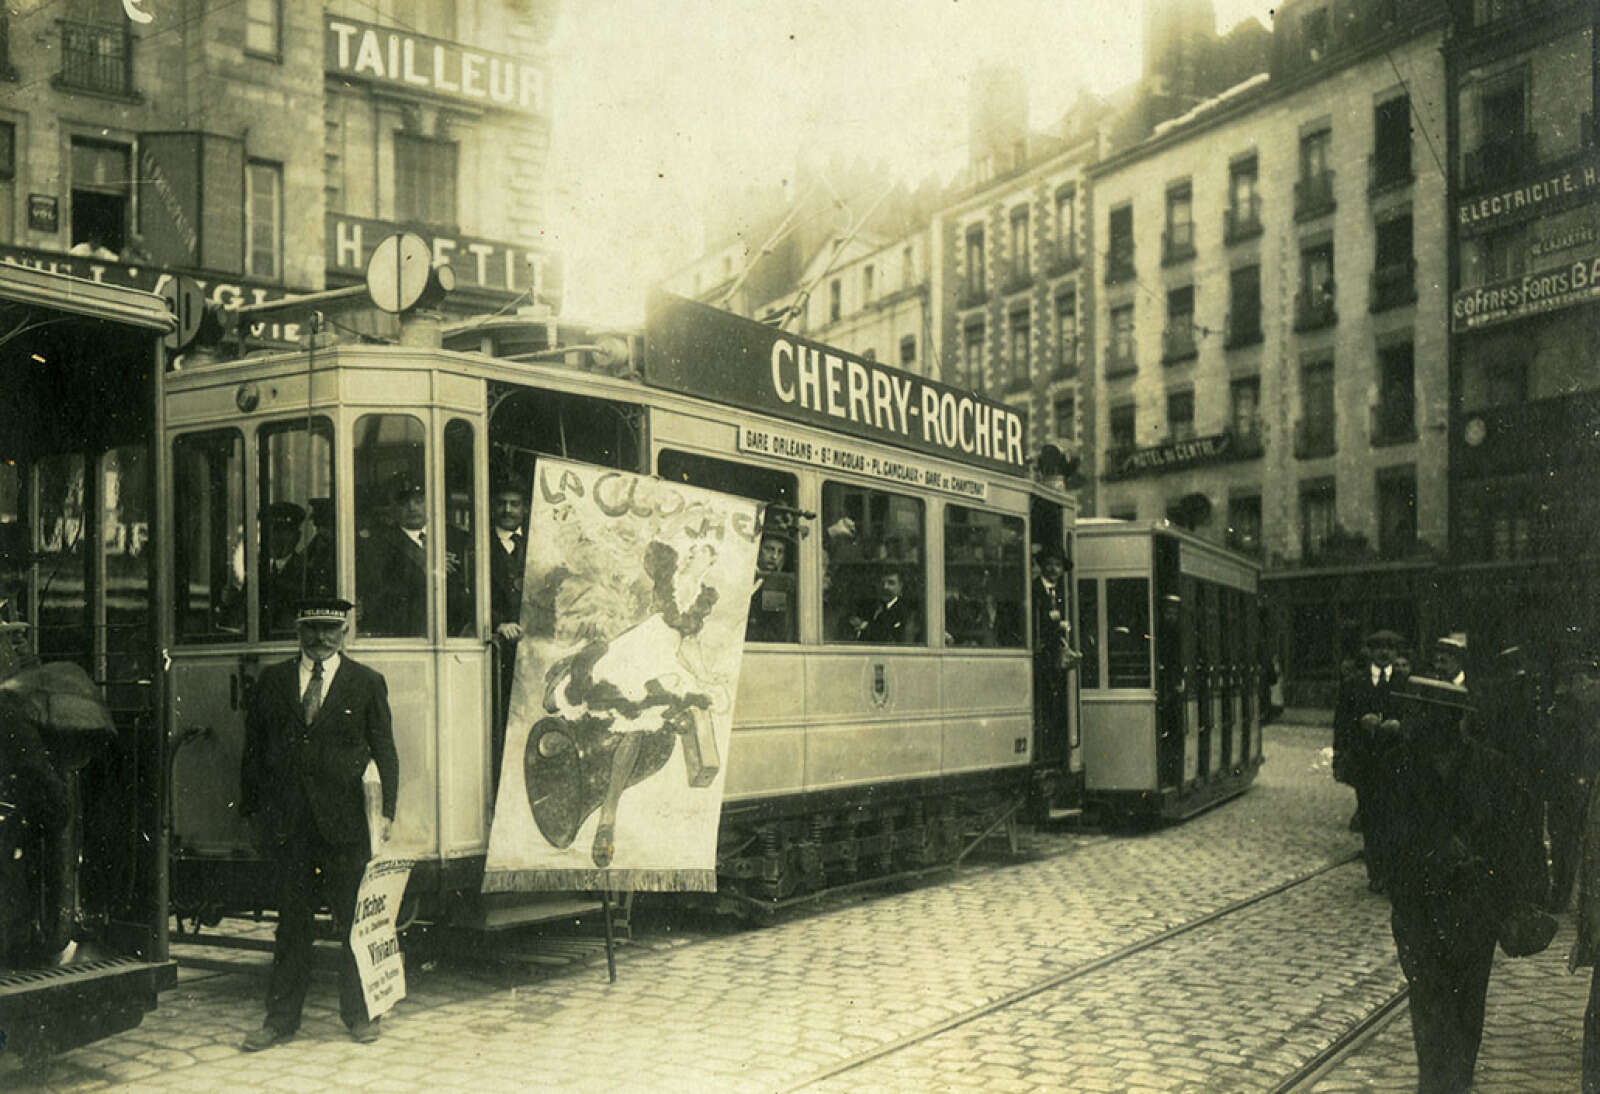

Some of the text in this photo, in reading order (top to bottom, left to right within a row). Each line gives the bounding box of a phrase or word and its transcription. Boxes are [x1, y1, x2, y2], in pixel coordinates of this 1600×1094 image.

[330, 22, 544, 112] TAILLEUR
[771, 339, 1023, 465] CHERRY-ROCHER
[539, 464, 585, 504] LA
[746, 430, 768, 451] GARE
[833, 449, 865, 471] NICOLAS
[925, 471, 941, 487] GARE
